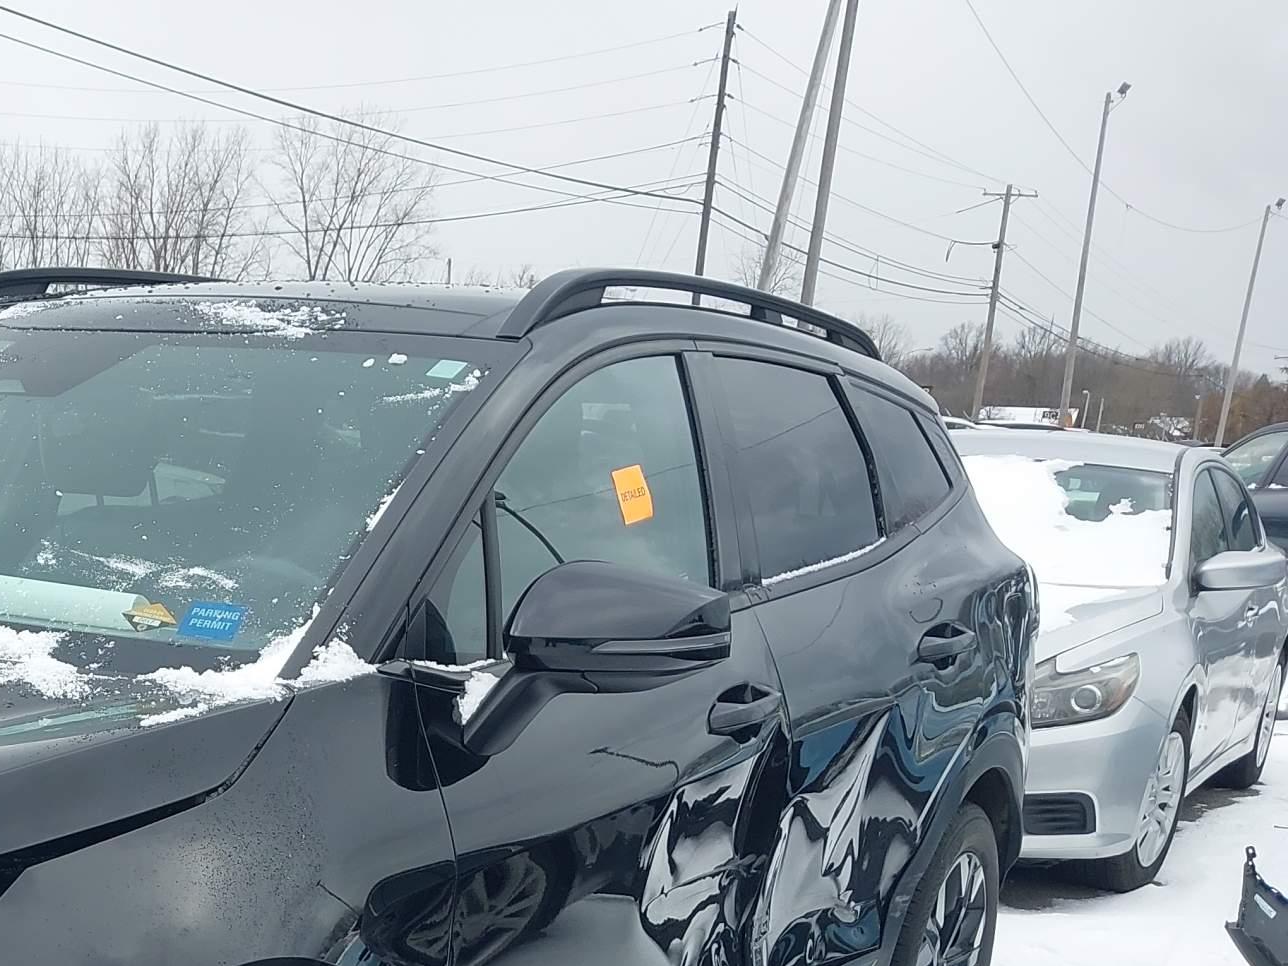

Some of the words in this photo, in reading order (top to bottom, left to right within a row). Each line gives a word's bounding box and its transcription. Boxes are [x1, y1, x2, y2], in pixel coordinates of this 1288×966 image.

[620, 486, 646, 502] DETAILED
[191, 607, 241, 621] PARKING
[188, 618, 233, 631] PERMIT
